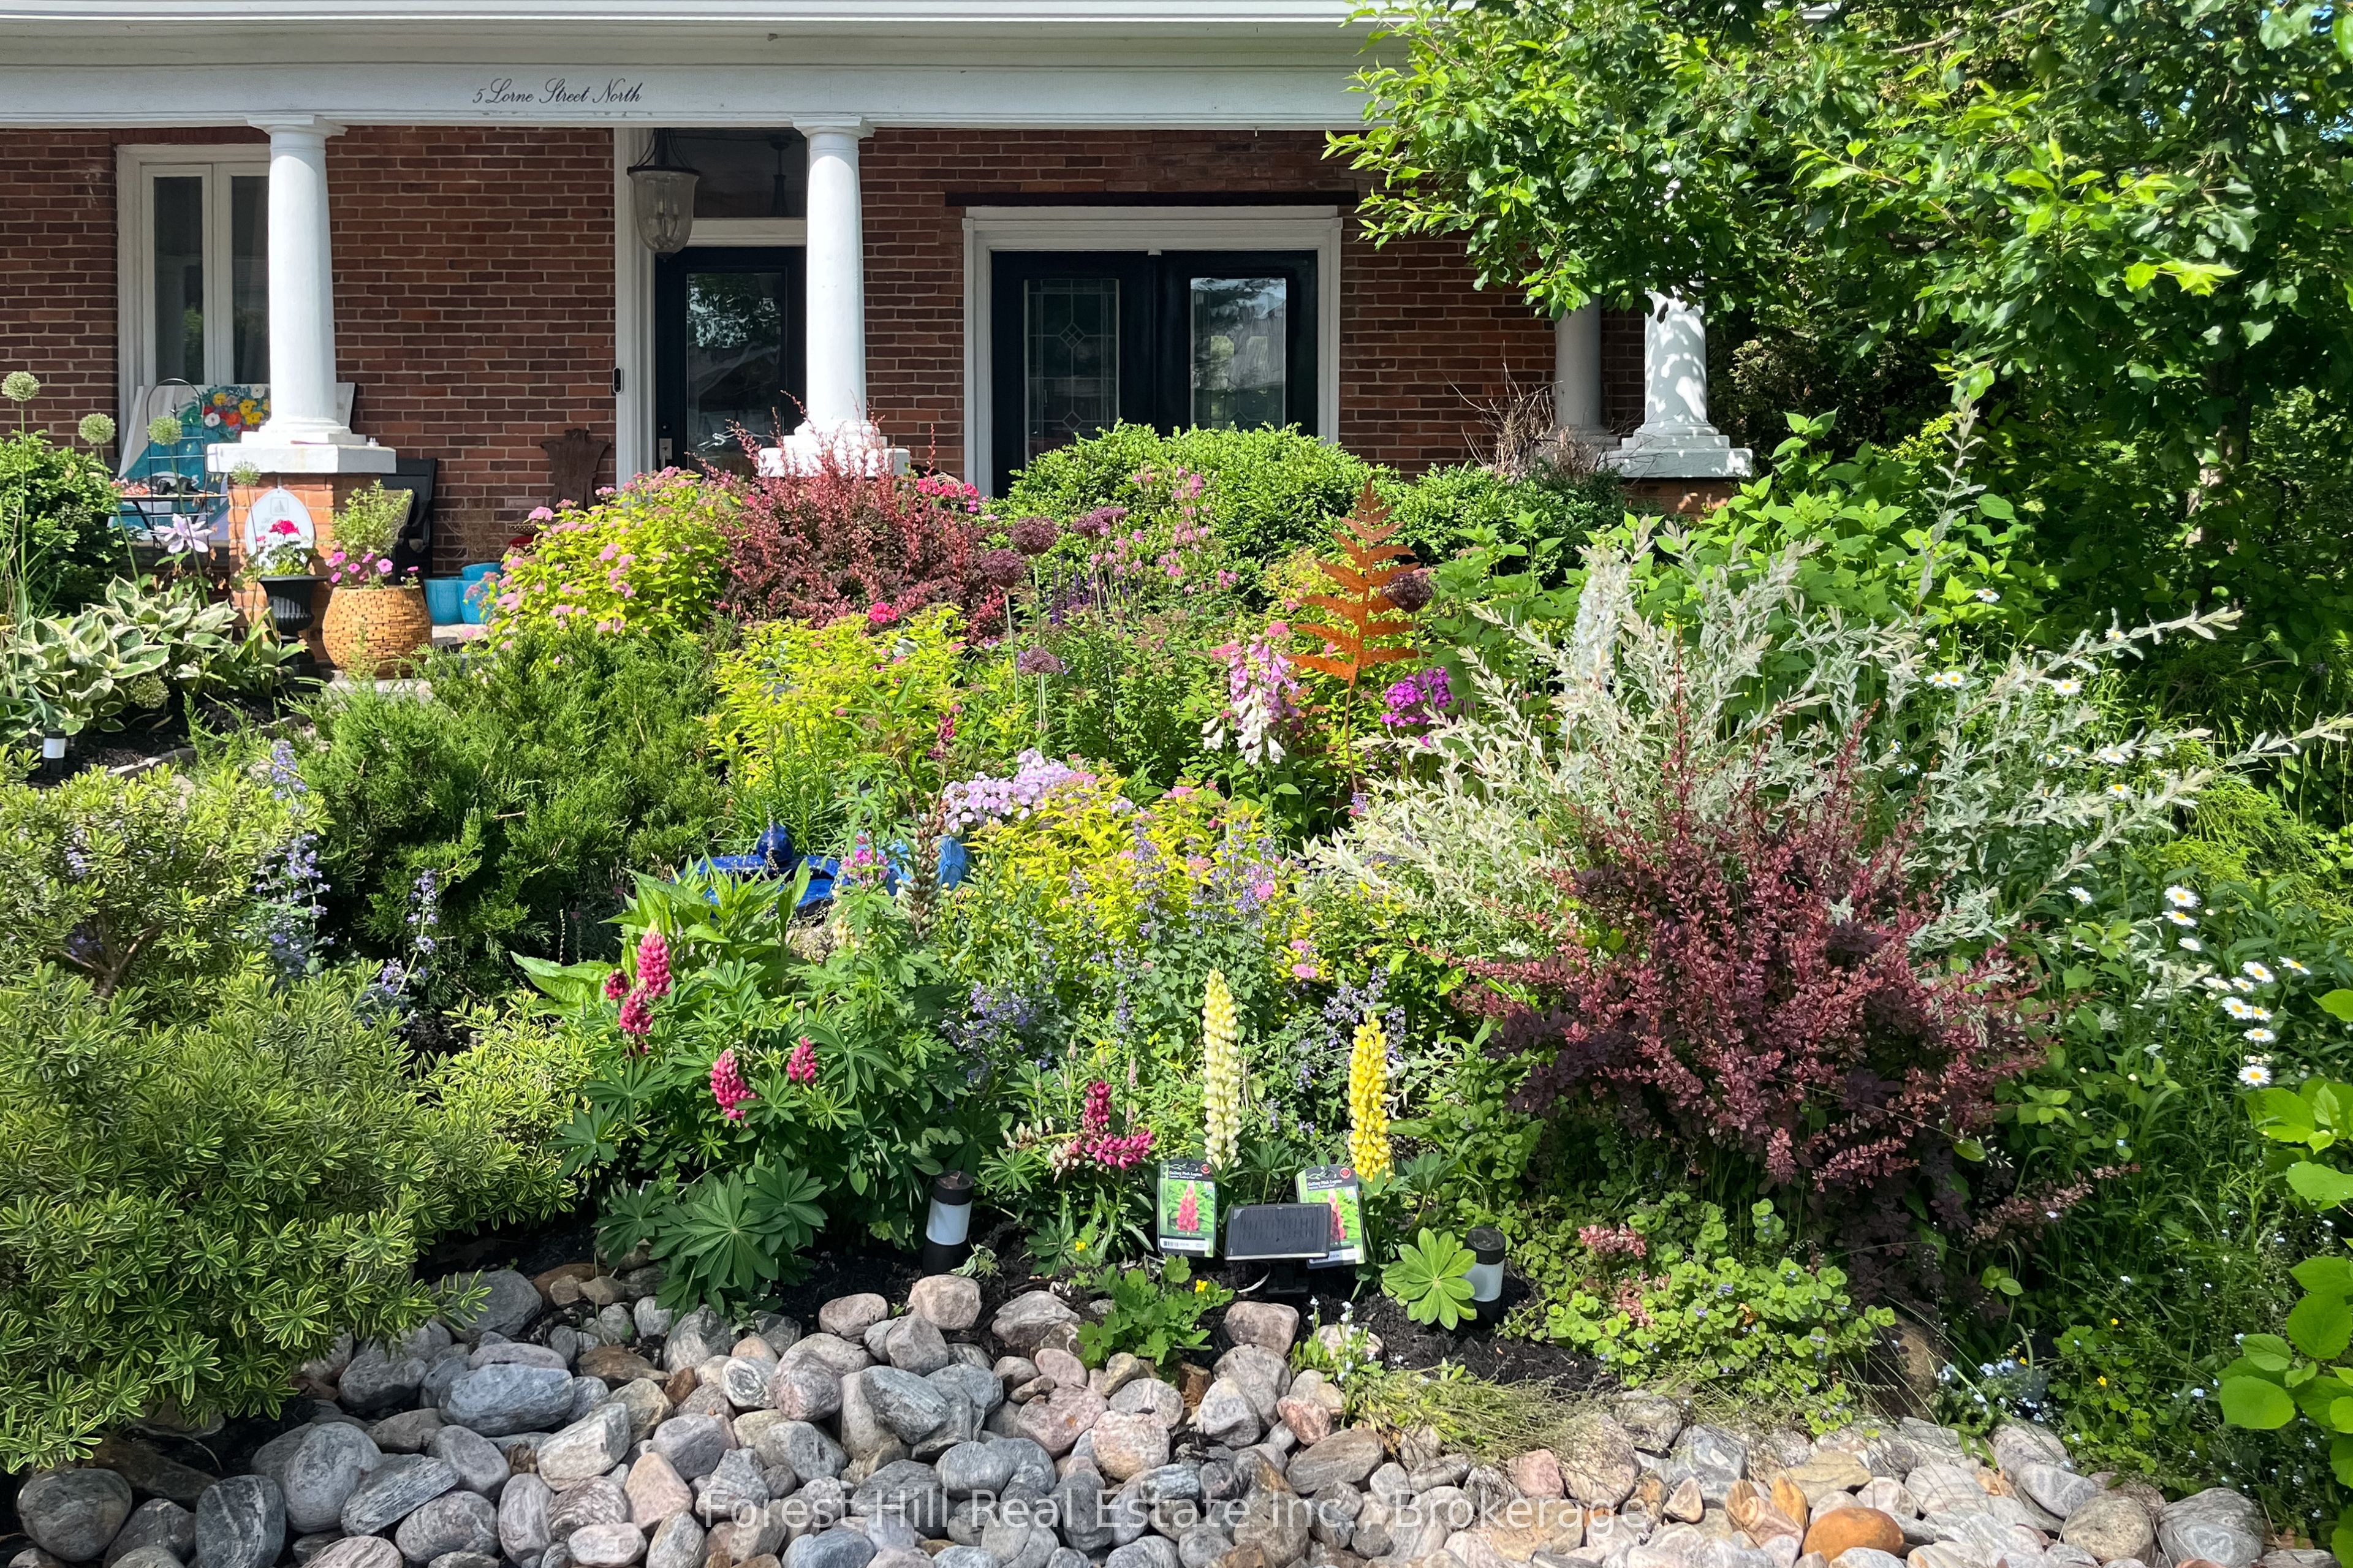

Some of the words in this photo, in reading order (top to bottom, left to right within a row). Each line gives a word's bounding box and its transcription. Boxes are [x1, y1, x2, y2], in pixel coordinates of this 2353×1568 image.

[472, 88, 487, 104] 5
[485, 78, 535, 104] Lorne
[539, 78, 591, 104] Street
[592, 77, 644, 104] North
